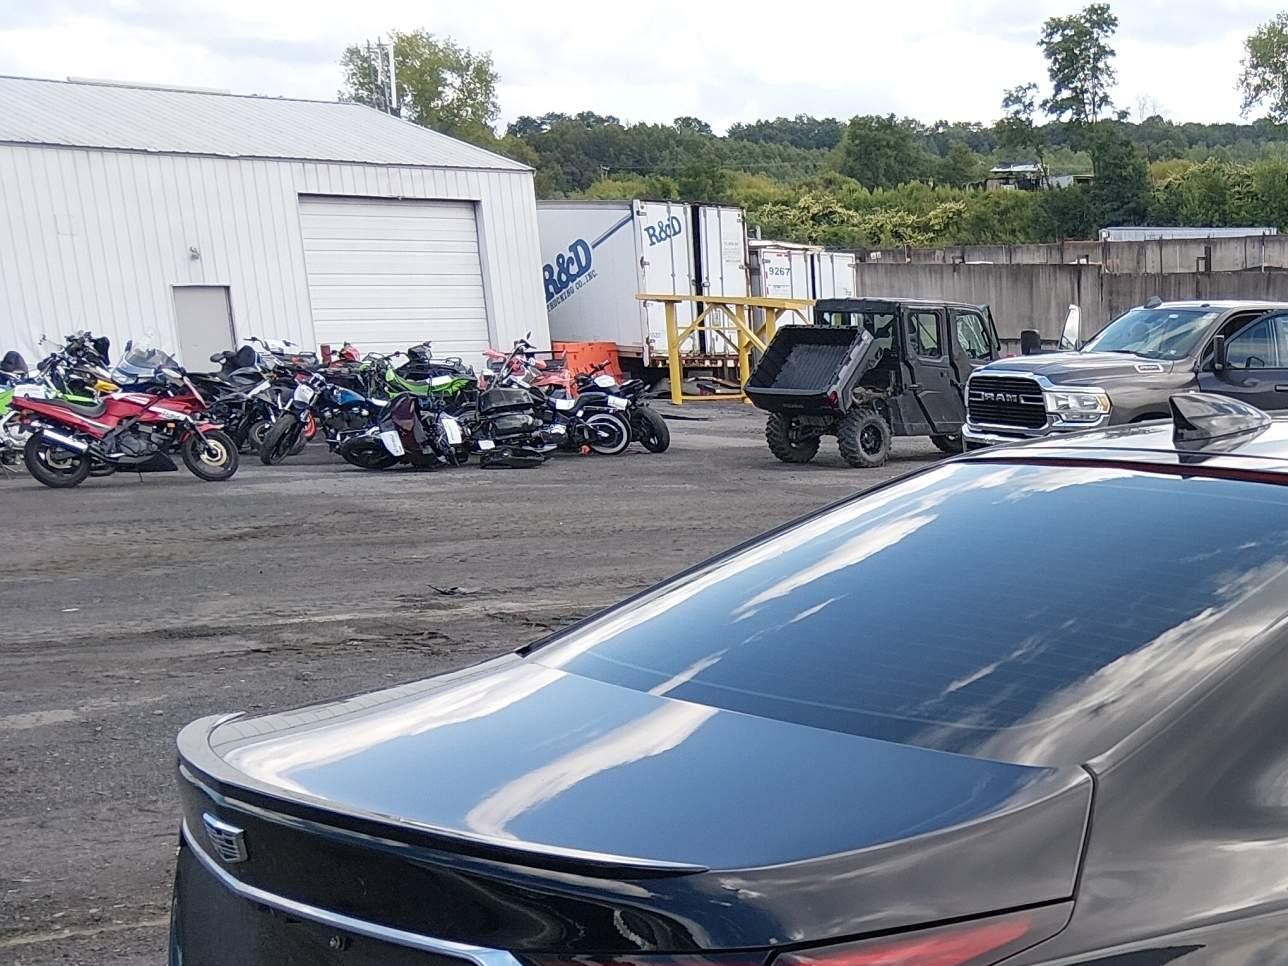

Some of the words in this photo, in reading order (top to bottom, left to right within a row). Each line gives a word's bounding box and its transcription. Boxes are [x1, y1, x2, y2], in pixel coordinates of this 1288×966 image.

[644, 216, 682, 247] R&D
[542, 238, 592, 303] R&D
[768, 266, 791, 277] 9267
[984, 392, 1018, 402] RAM
